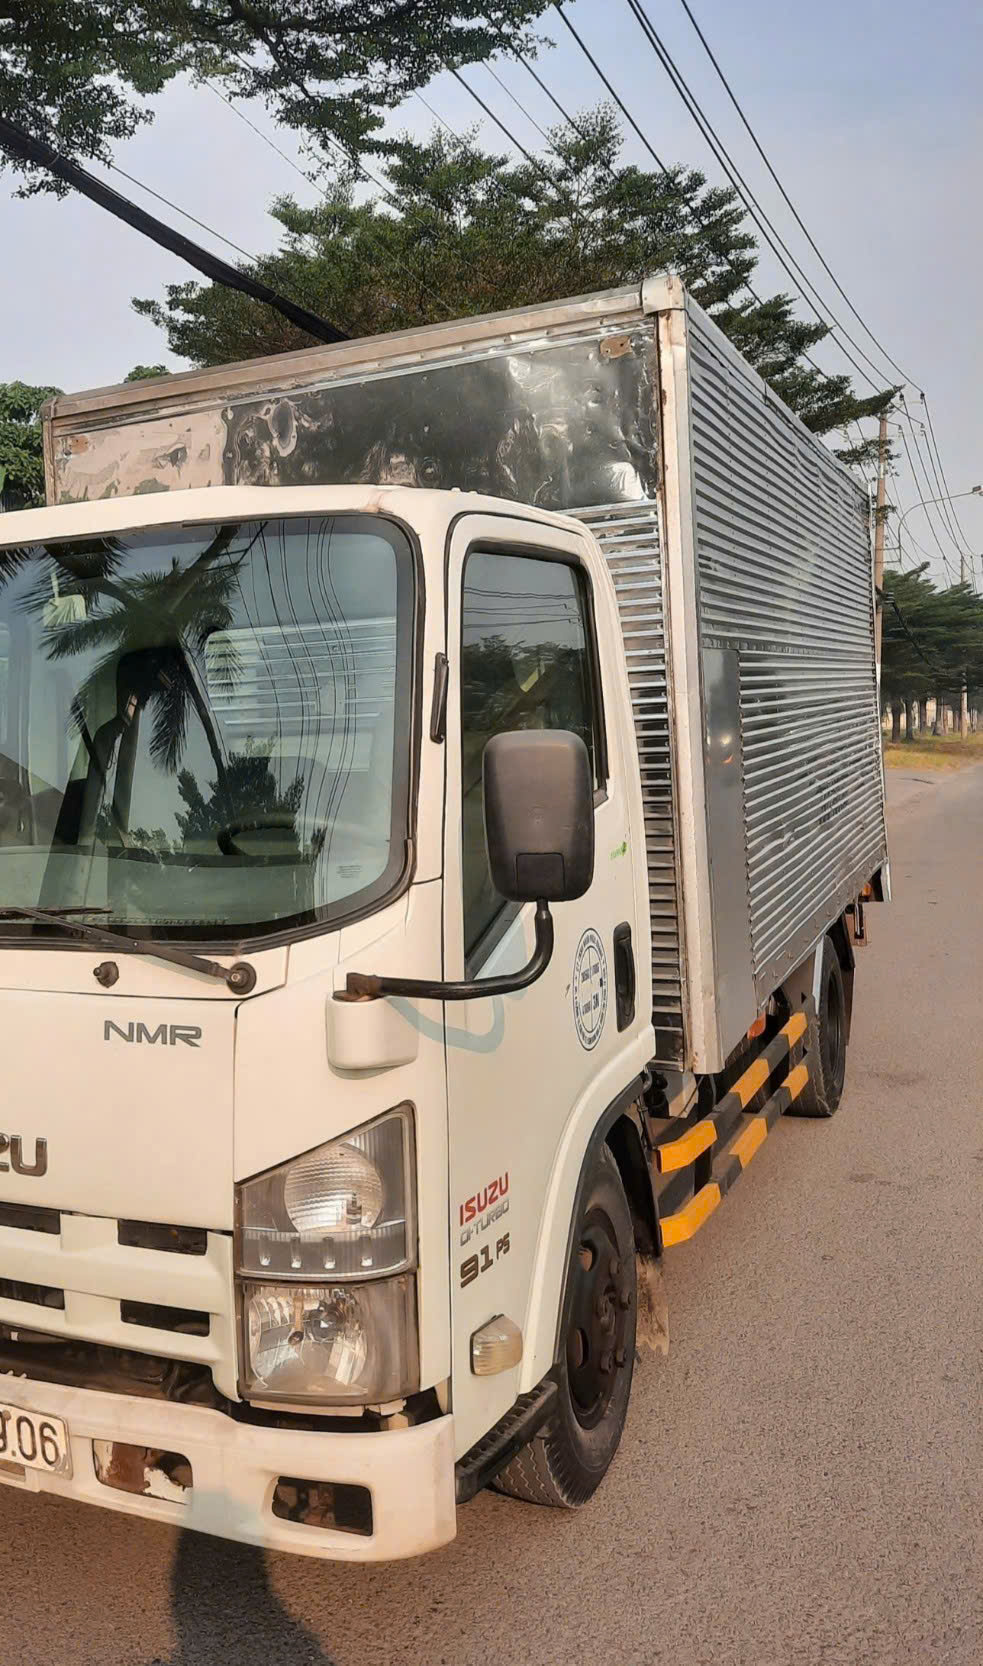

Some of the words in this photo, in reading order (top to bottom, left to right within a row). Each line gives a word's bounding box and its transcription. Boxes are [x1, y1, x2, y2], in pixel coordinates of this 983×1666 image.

[104, 1020, 202, 1047] NMR
[0, 1132, 48, 1177] U
[459, 1172, 509, 1226] ISUZU
[460, 1244, 494, 1289] 91
[496, 1232, 510, 1260] PS
